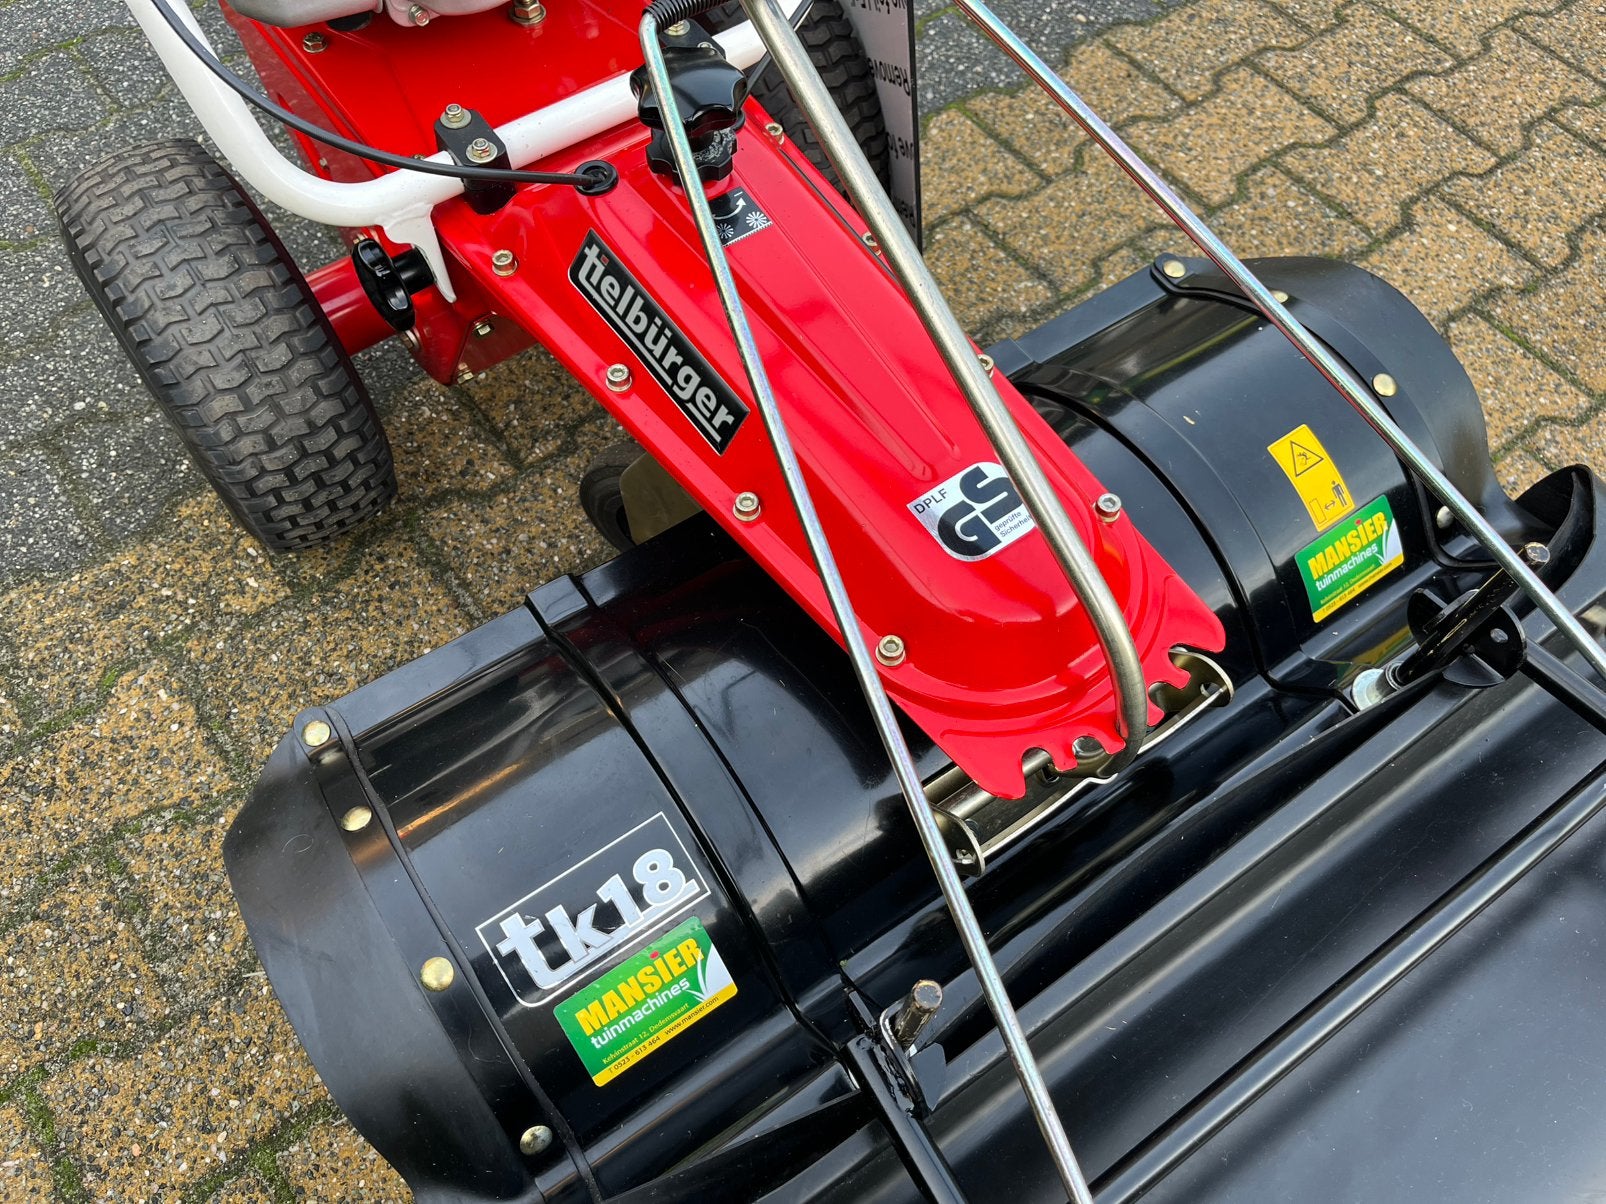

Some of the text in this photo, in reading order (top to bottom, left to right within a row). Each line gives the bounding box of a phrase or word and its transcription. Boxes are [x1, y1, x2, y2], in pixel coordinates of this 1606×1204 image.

[867, 57, 911, 97] Remove
[578, 244, 735, 437] tielbürger
[913, 488, 948, 515] DPLF
[1308, 511, 1389, 580] MANSIER
[1315, 543, 1378, 592] tuinmachines
[495, 848, 701, 990] tk18
[575, 938, 705, 1036] MANSIER
[590, 977, 691, 1049] tuinmachines
[601, 1037, 639, 1065] Kelvinstraat
[648, 1002, 690, 1034] Dedemsvaart
[613, 1056, 631, 1071] 0523
[634, 1044, 648, 1057] 613
[648, 1035, 661, 1047] 464
[664, 995, 719, 1036] www.mansier.com
